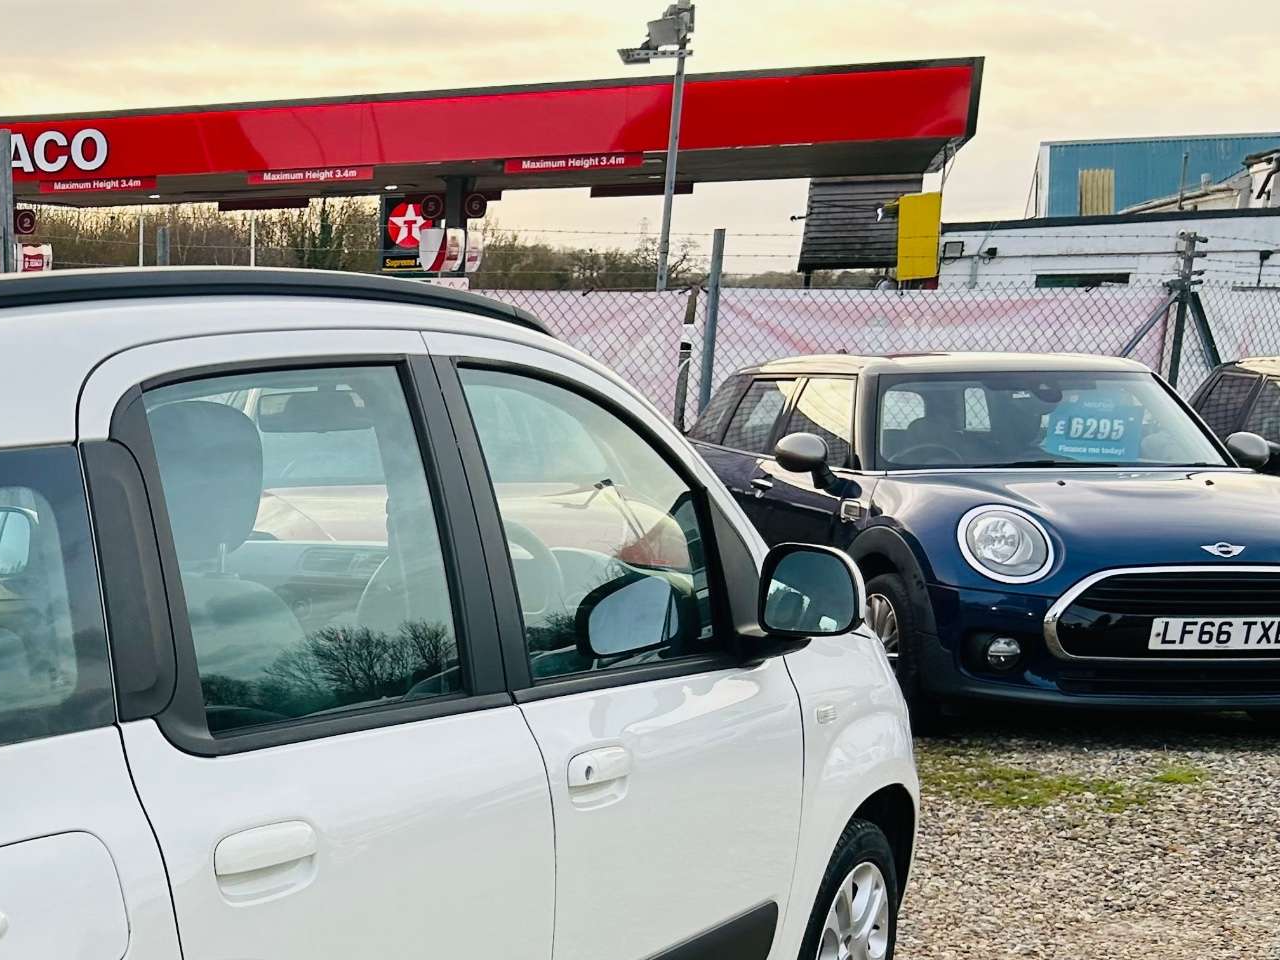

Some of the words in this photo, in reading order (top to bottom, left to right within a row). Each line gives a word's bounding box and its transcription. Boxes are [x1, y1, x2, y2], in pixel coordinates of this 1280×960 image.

[521, 159, 565, 169] Maximum
[567, 157, 598, 168] Height
[600, 156, 625, 166] 3.4m
[263, 171, 303, 181] Maximum
[305, 169, 333, 180] Height
[335, 169, 357, 178] 3.4m
[53, 180, 91, 190] Maximum
[92, 179, 119, 190] Height
[121, 178, 141, 188] 3.4m
[428, 202, 437, 211] 5
[471, 201, 480, 210] 6
[23, 218, 32, 227] 2
[1054, 420, 1066, 435] £
[1070, 417, 1124, 440] 6295
[1160, 621, 1233, 645] LF66
